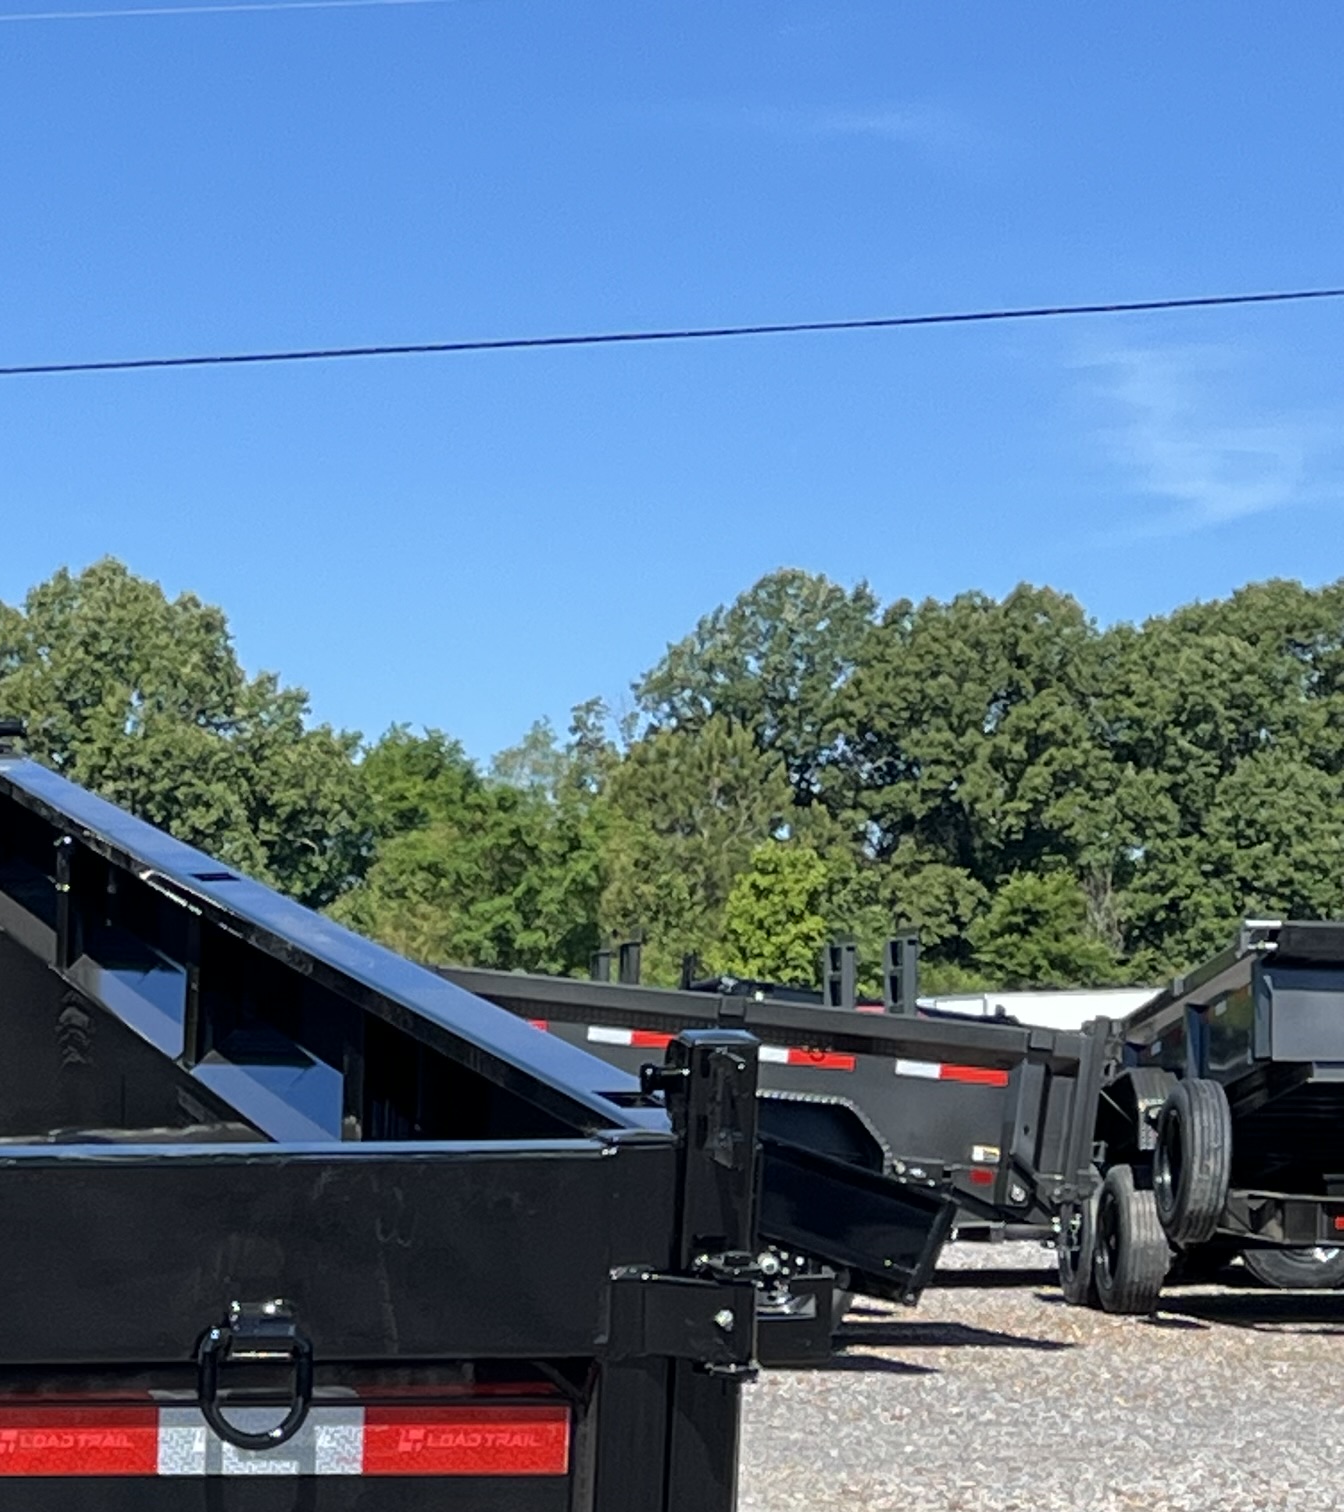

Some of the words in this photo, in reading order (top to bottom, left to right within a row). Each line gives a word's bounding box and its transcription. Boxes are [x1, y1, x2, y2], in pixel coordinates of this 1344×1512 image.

[19, 1434, 74, 1449] LOAD
[77, 1434, 135, 1449] TRAIL
[427, 1433, 482, 1447] LOAD
[485, 1432, 542, 1447] TRAIL
